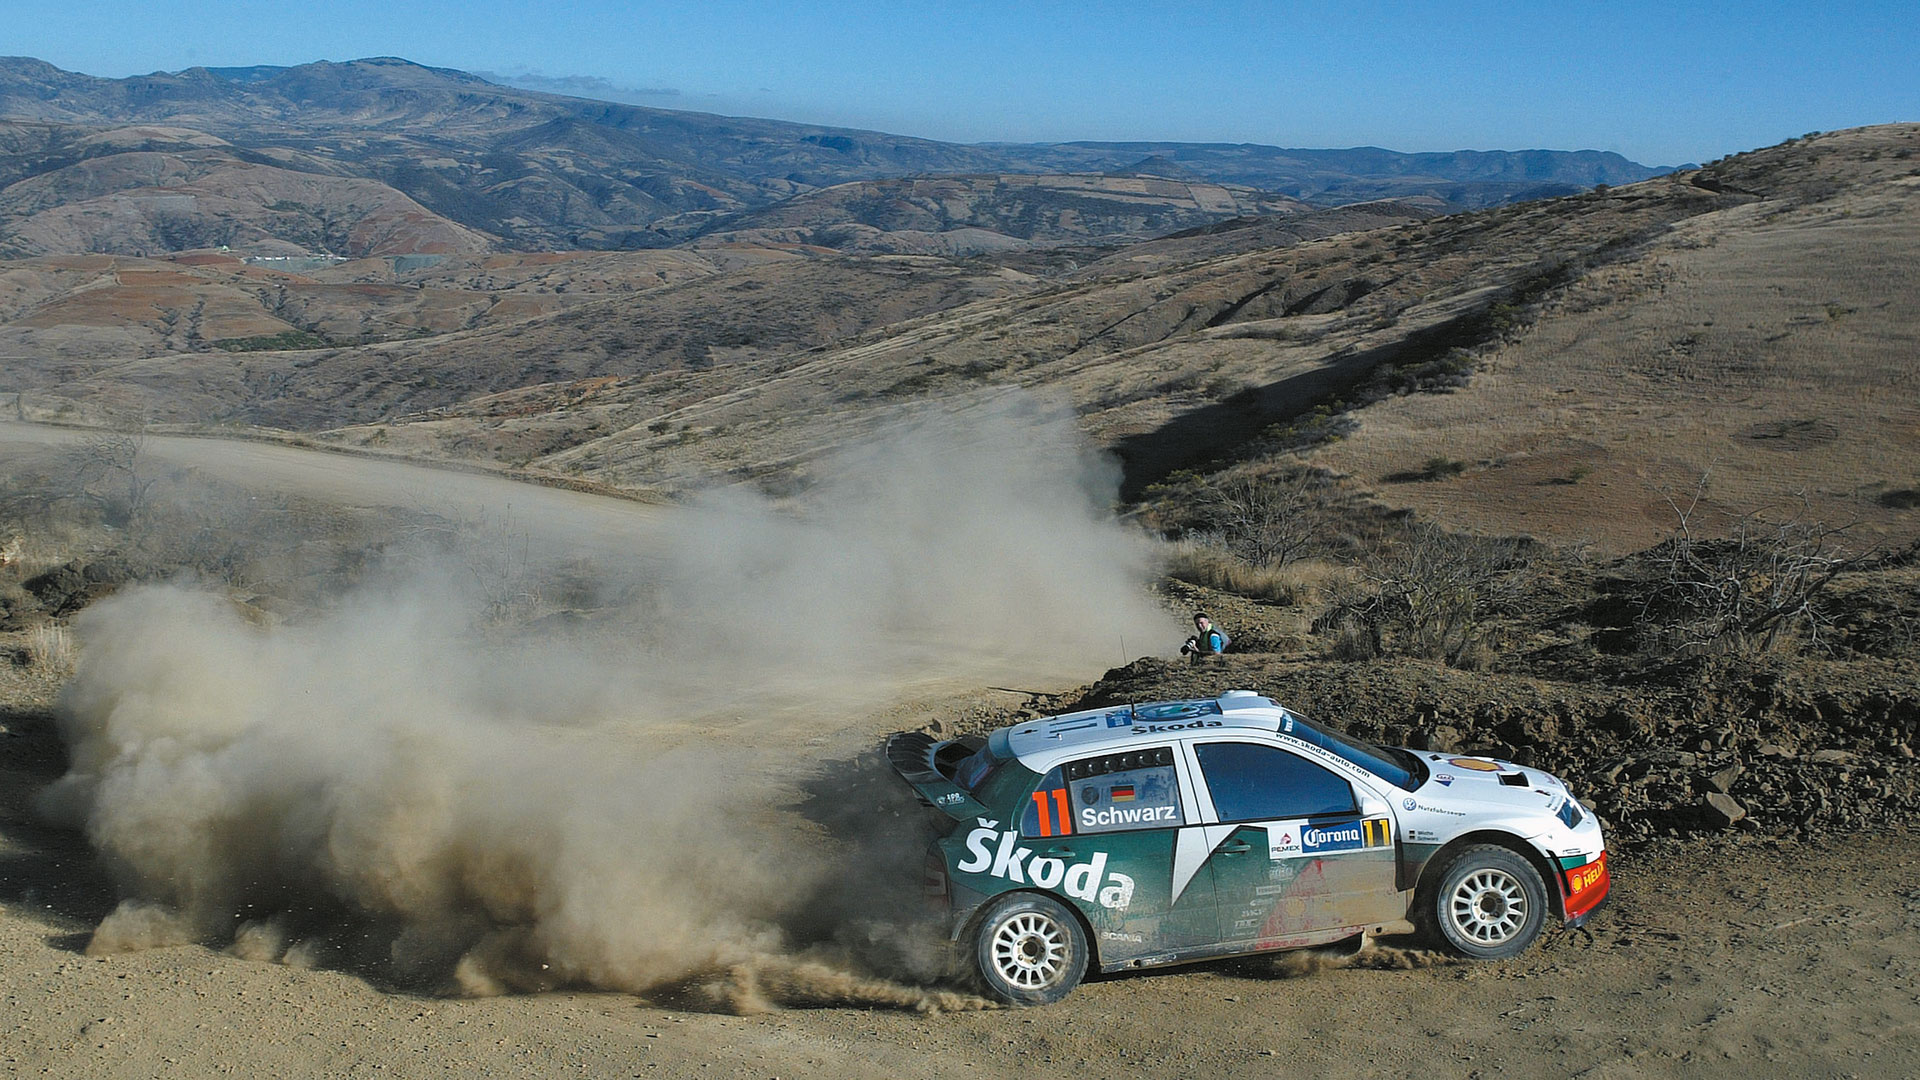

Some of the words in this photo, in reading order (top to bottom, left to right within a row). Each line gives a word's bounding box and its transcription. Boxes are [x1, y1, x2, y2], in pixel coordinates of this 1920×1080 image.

[1276, 733, 1370, 778] www.skoda-auto.com
[1032, 788, 1071, 837] 11
[1081, 805, 1177, 827] Schwarz
[1303, 828, 1360, 848] Corona
[1363, 820, 1390, 847] 11
[957, 817, 1135, 912] Škoda
